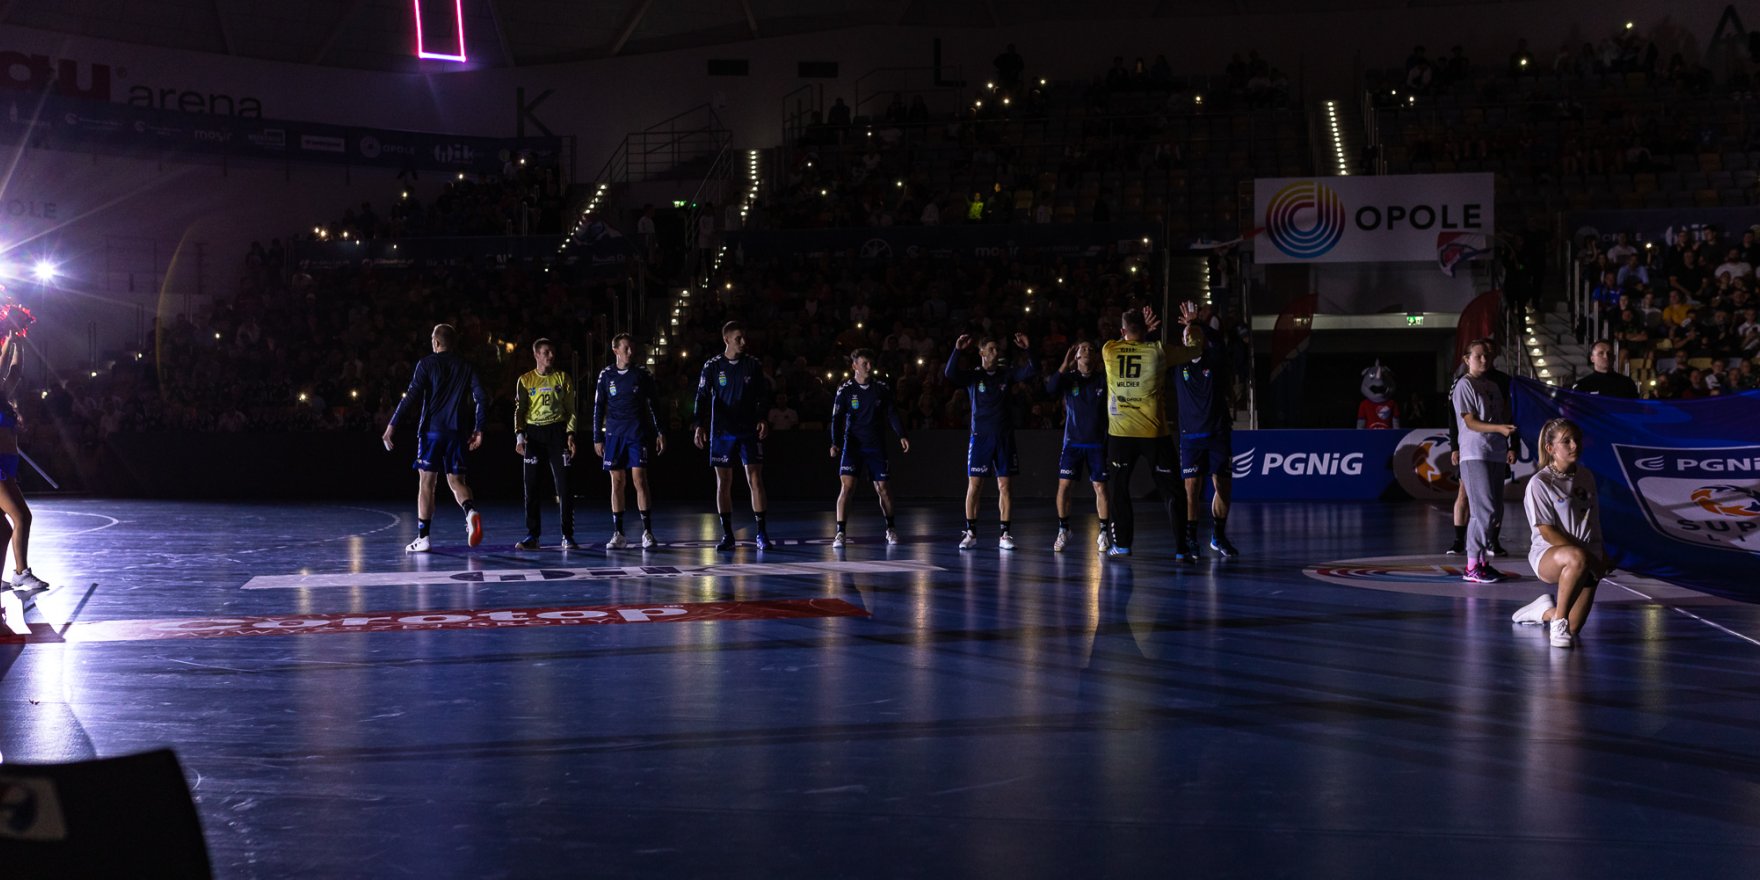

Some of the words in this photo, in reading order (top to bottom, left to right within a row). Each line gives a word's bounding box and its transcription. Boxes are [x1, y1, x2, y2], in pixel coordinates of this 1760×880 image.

[128, 84, 262, 121] arena
[516, 87, 557, 138] K
[1355, 204, 1482, 231] OPOLE
[1116, 354, 1142, 379] 16
[541, 393, 551, 406] 12
[1261, 451, 1364, 476] PGNiG
[1677, 520, 1758, 532] SUP
[150, 607, 689, 632] corotop
